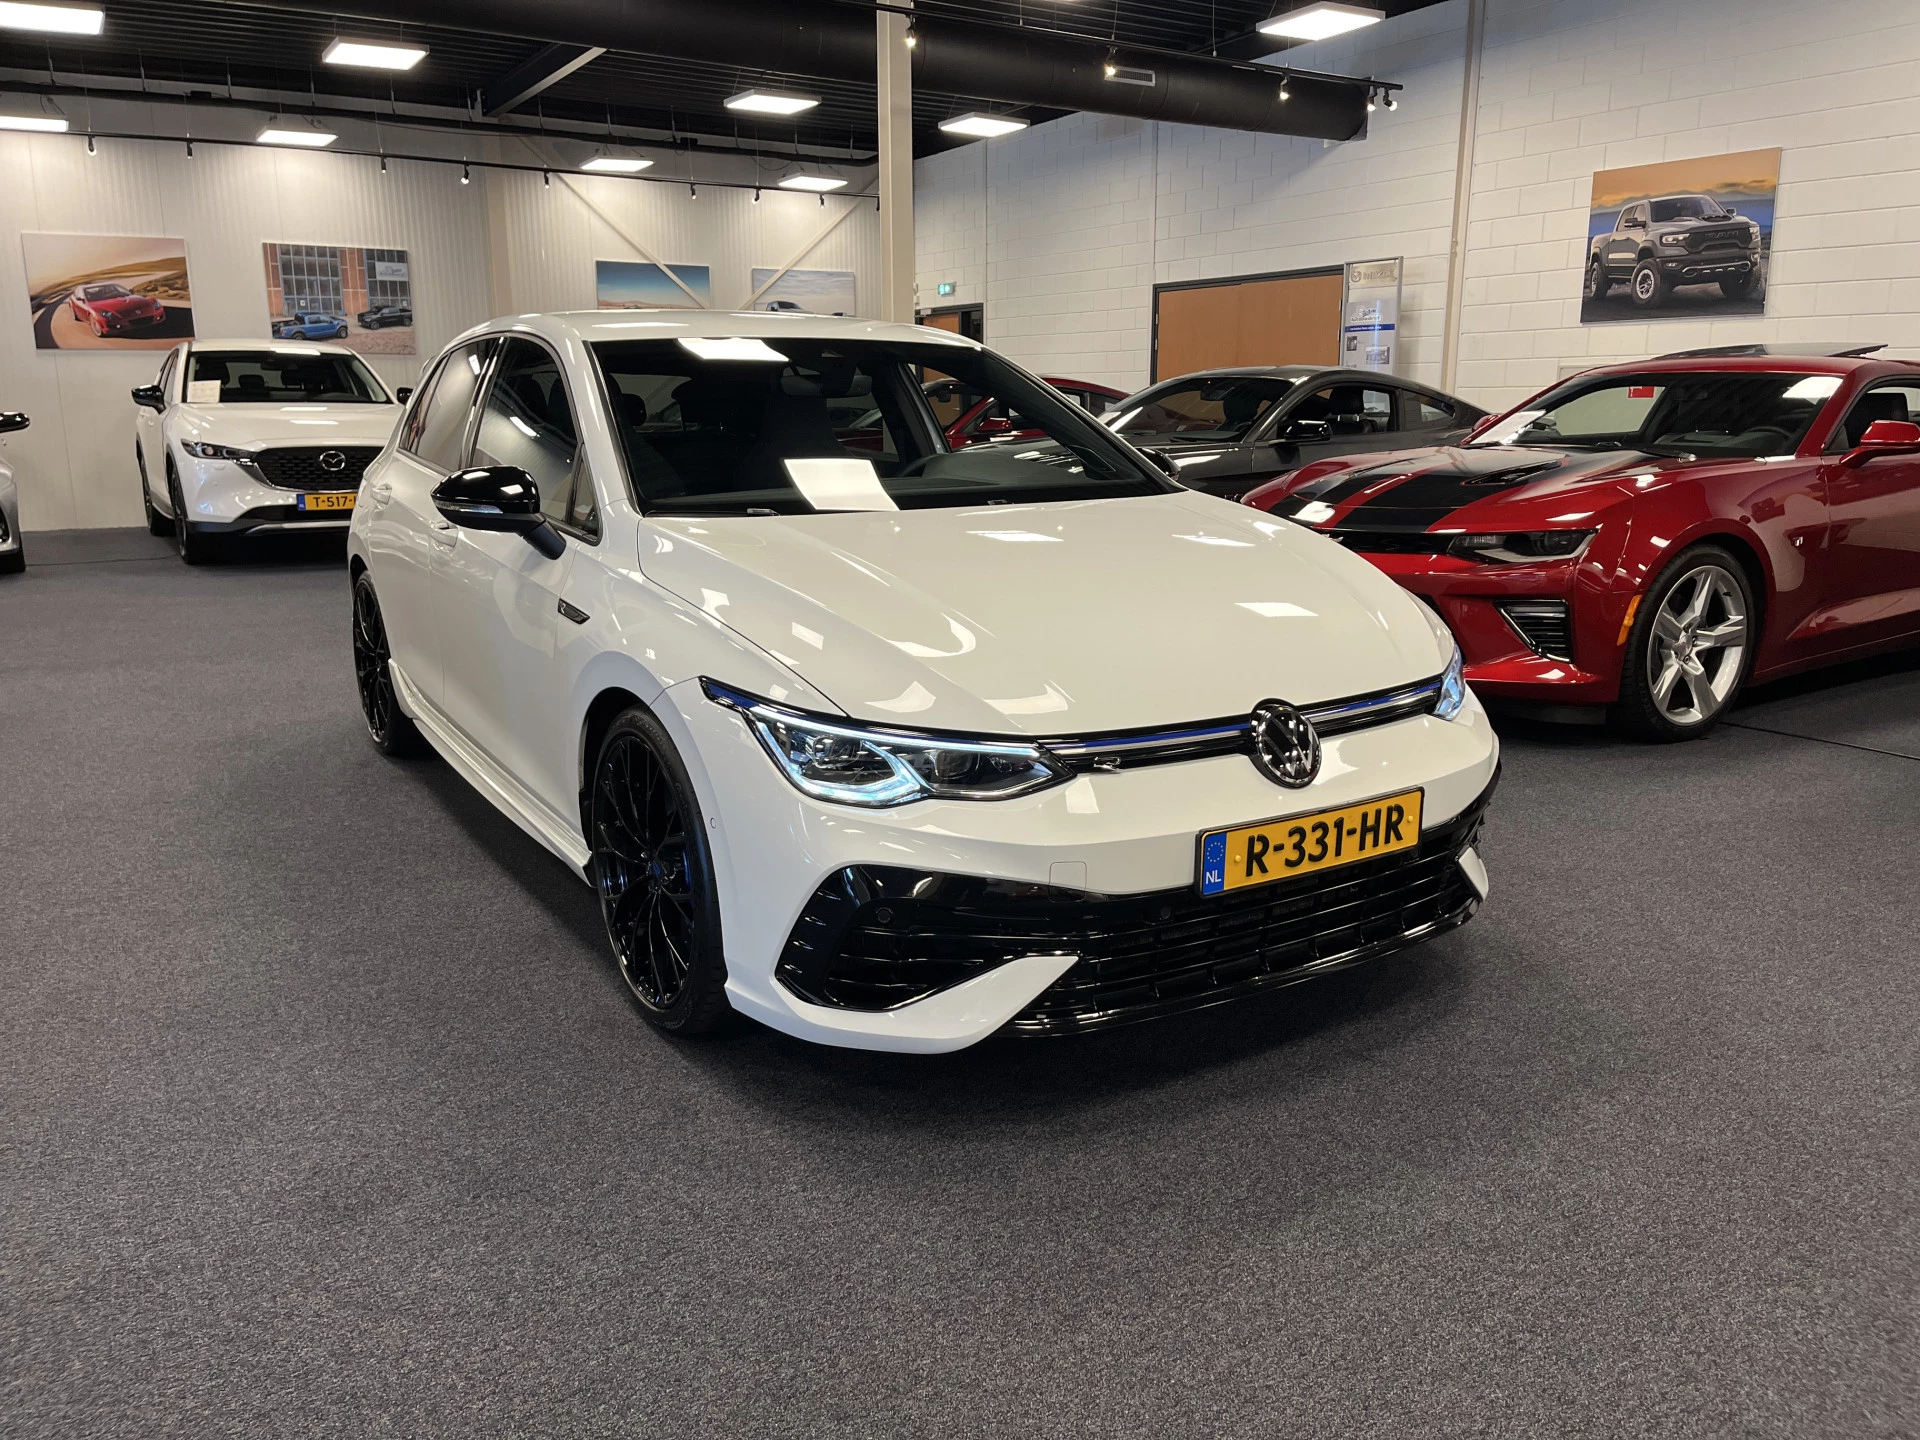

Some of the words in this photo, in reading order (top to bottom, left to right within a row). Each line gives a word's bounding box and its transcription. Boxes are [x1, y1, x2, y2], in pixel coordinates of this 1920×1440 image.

[313, 496, 357, 508] T-517-
[1245, 803, 1405, 878] R-331-HR
[1205, 869, 1222, 885] NL
